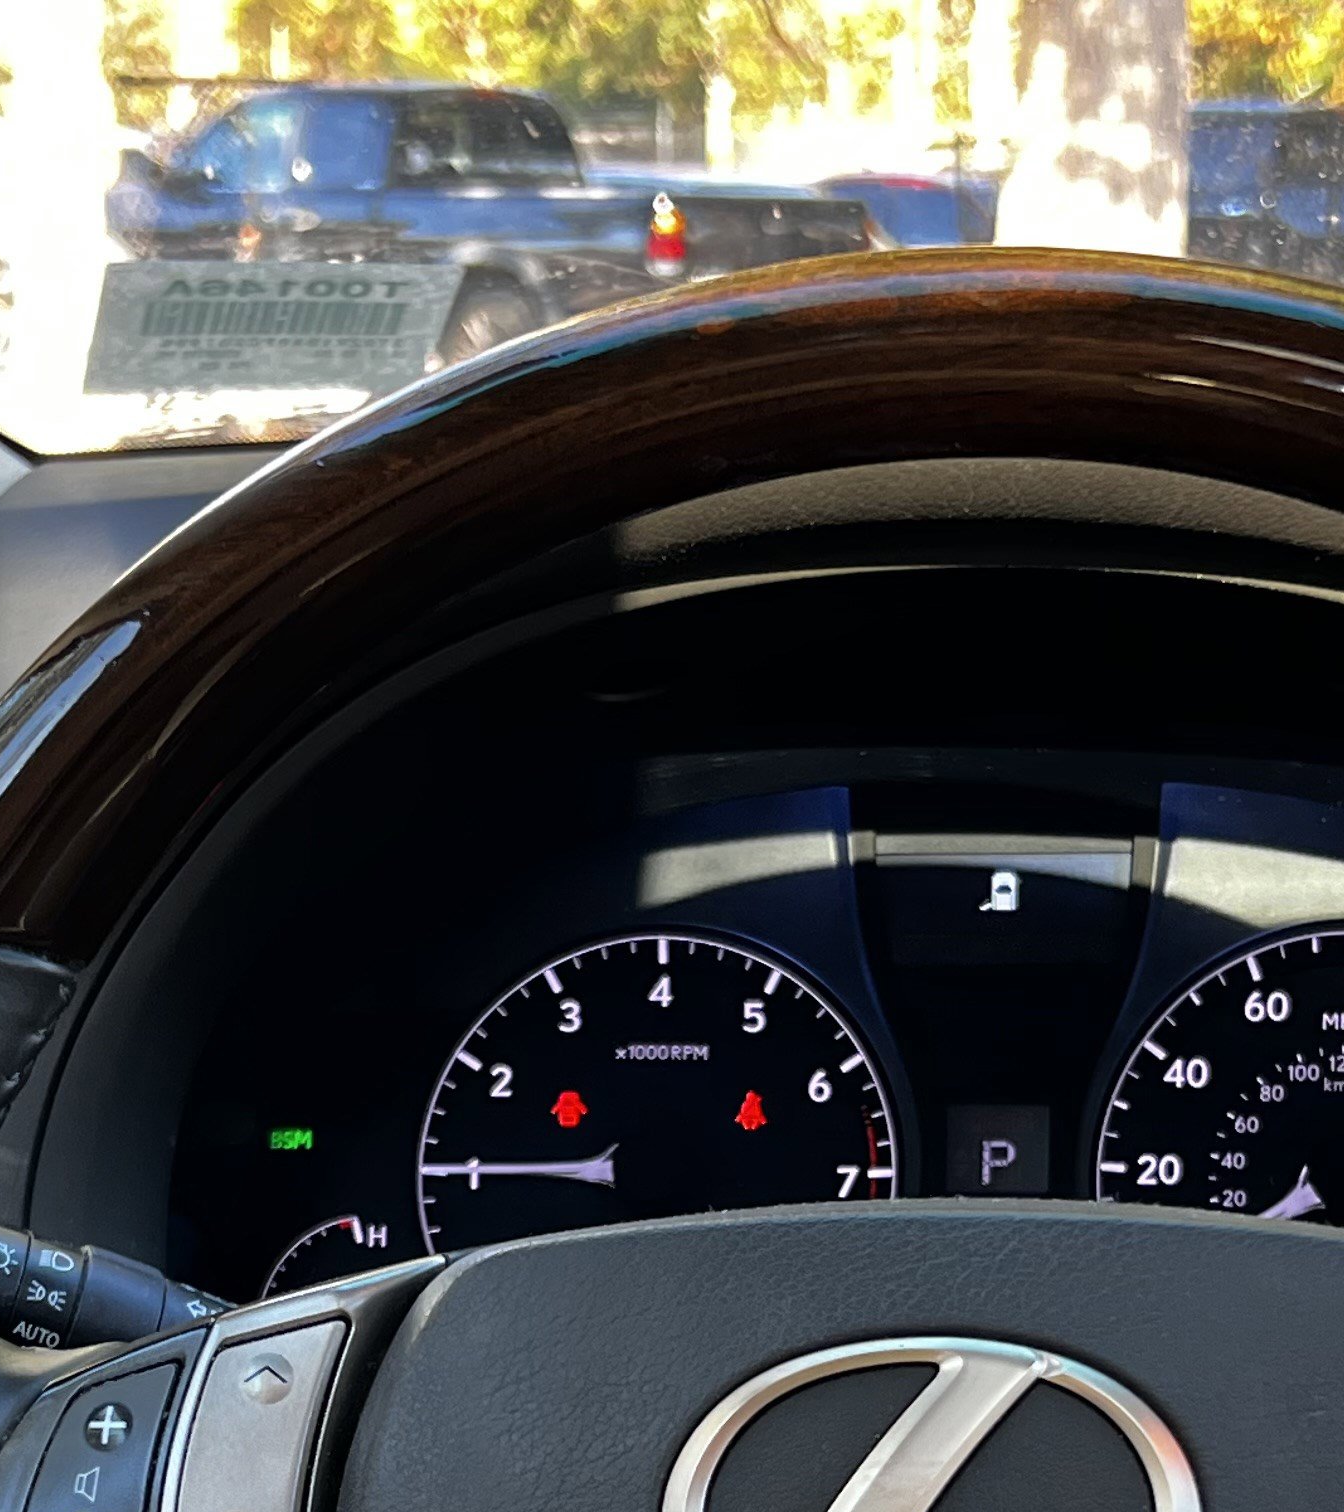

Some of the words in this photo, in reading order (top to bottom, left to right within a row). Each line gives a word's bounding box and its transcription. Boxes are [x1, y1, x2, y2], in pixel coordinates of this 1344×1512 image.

[648, 976, 673, 1007] 4
[1244, 992, 1290, 1022] 60
[558, 1000, 583, 1033] 3
[743, 1000, 768, 1033] 5
[489, 1063, 513, 1098] 2
[807, 1069, 833, 1103] 6
[1162, 1058, 1211, 1089] 40
[1287, 1064, 1320, 1083] 100
[1259, 1084, 1285, 1103] 80
[1234, 1115, 1260, 1134] 60
[981, 1140, 1017, 1186] P
[1136, 1155, 1183, 1186] 20
[1221, 1152, 1246, 1171] 40
[836, 1165, 860, 1199] 7
[1222, 1189, 1247, 1208] 20
[366, 1223, 388, 1248] H
[12, 1320, 61, 1349] AUTO
